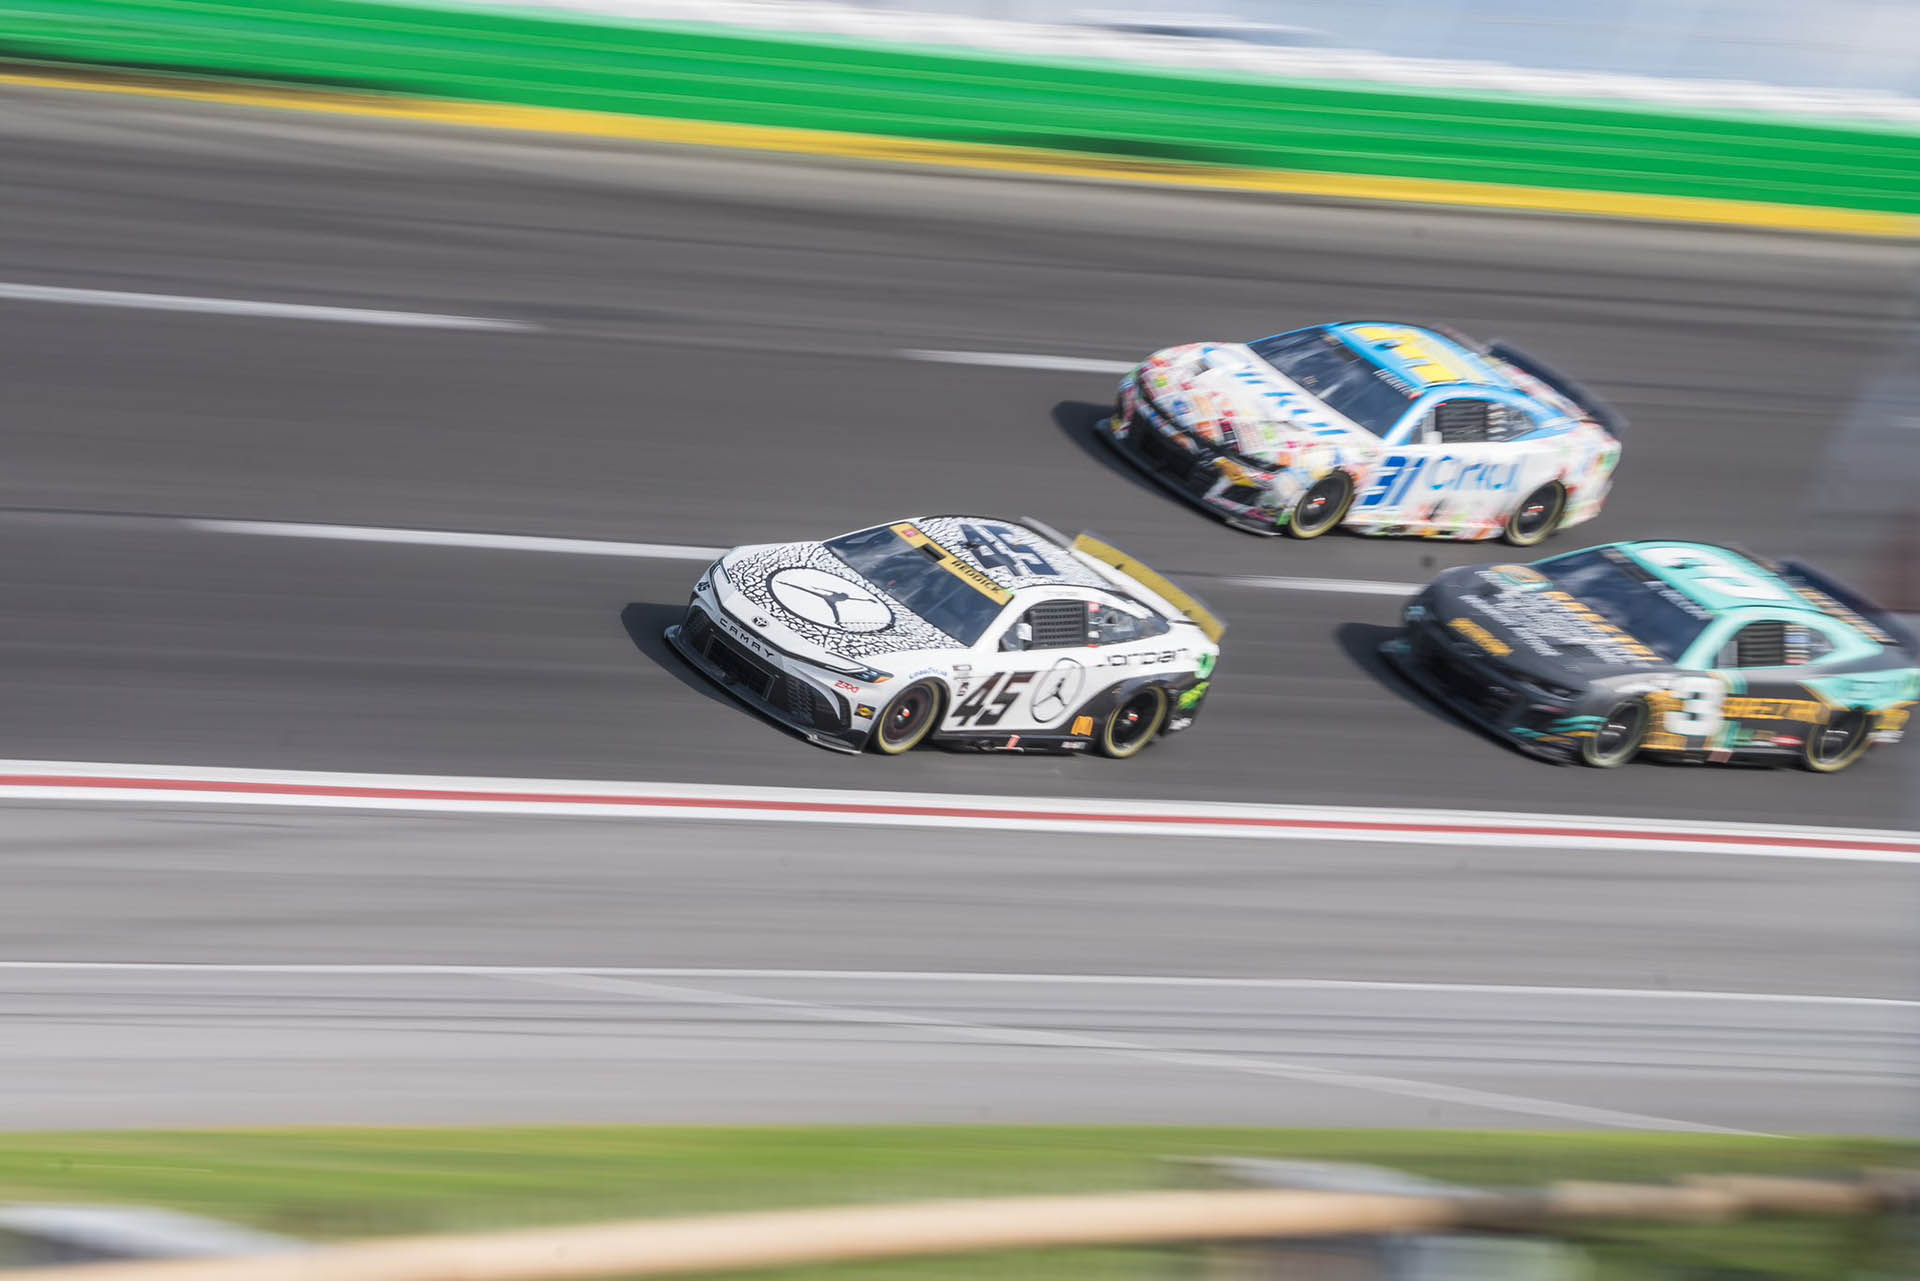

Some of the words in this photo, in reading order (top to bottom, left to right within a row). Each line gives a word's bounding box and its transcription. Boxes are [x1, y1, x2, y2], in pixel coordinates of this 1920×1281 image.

[951, 560, 1000, 594] REDDICK
[955, 524, 1060, 577] 45
[720, 618, 775, 658] CAMRY
[951, 671, 1037, 726] 45
[1663, 676, 1727, 736] 3
